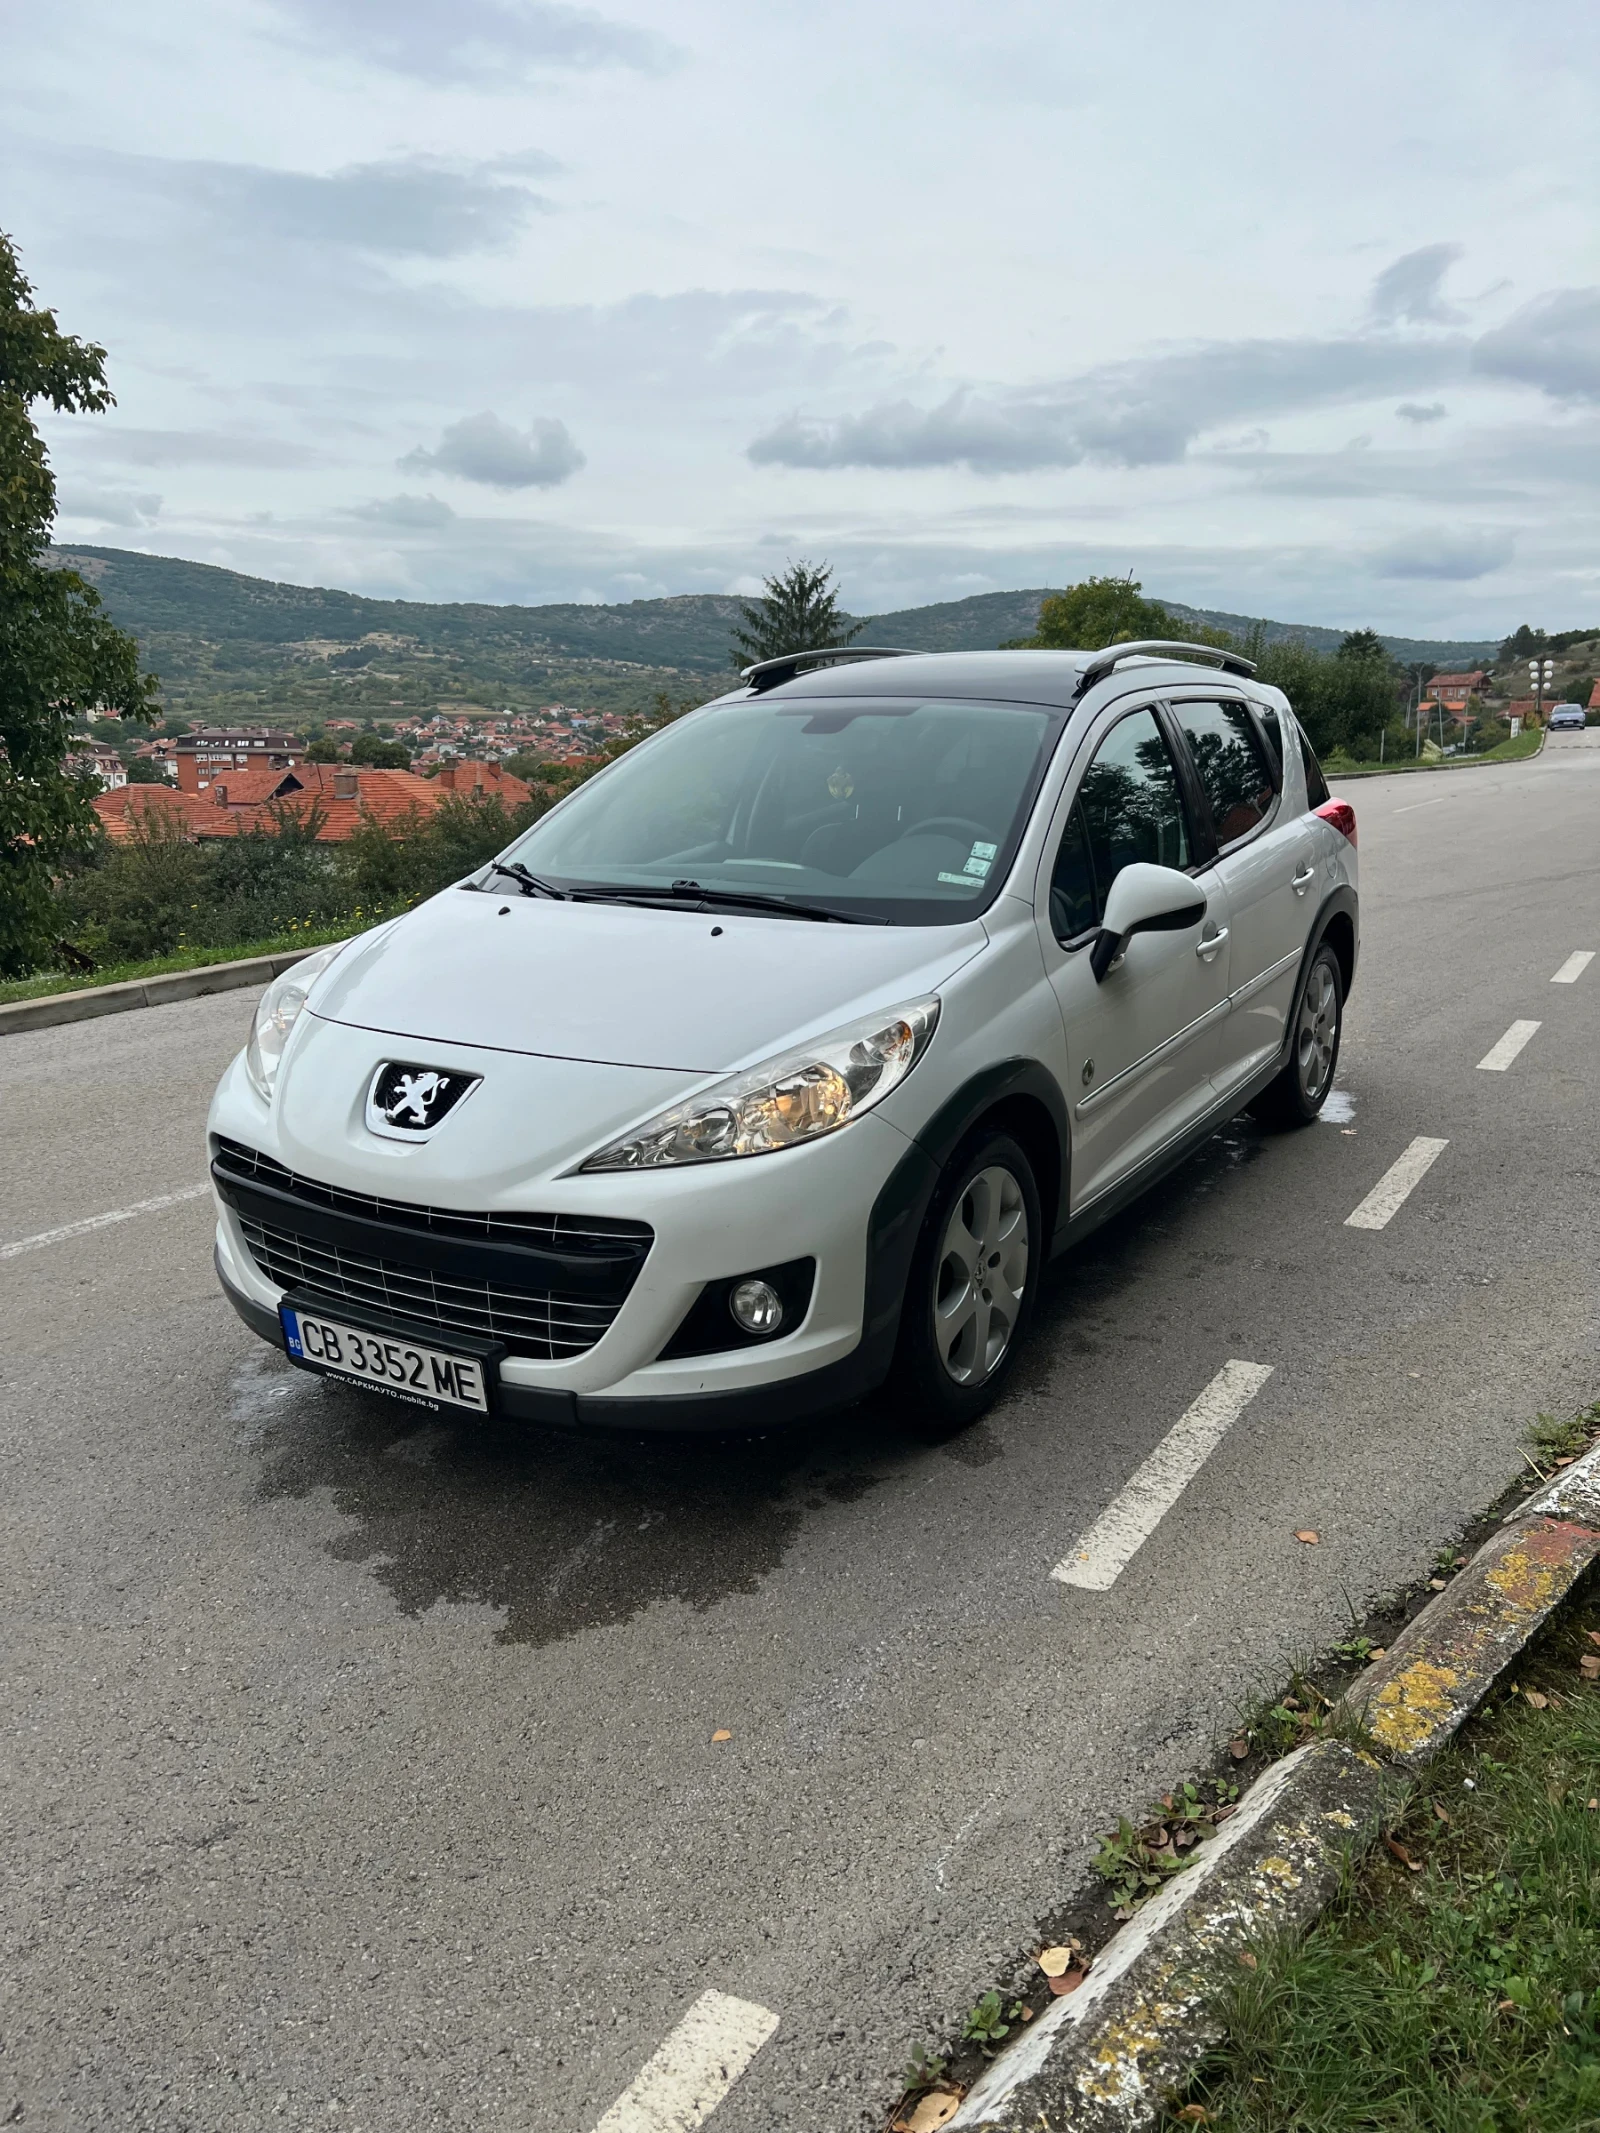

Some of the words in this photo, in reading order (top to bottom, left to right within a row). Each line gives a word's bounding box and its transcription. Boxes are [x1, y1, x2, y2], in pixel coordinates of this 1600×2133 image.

[288, 1336, 302, 1350] BG
[301, 1319, 343, 1363] CB
[347, 1332, 428, 1390] 3352
[430, 1354, 481, 1405] ME
